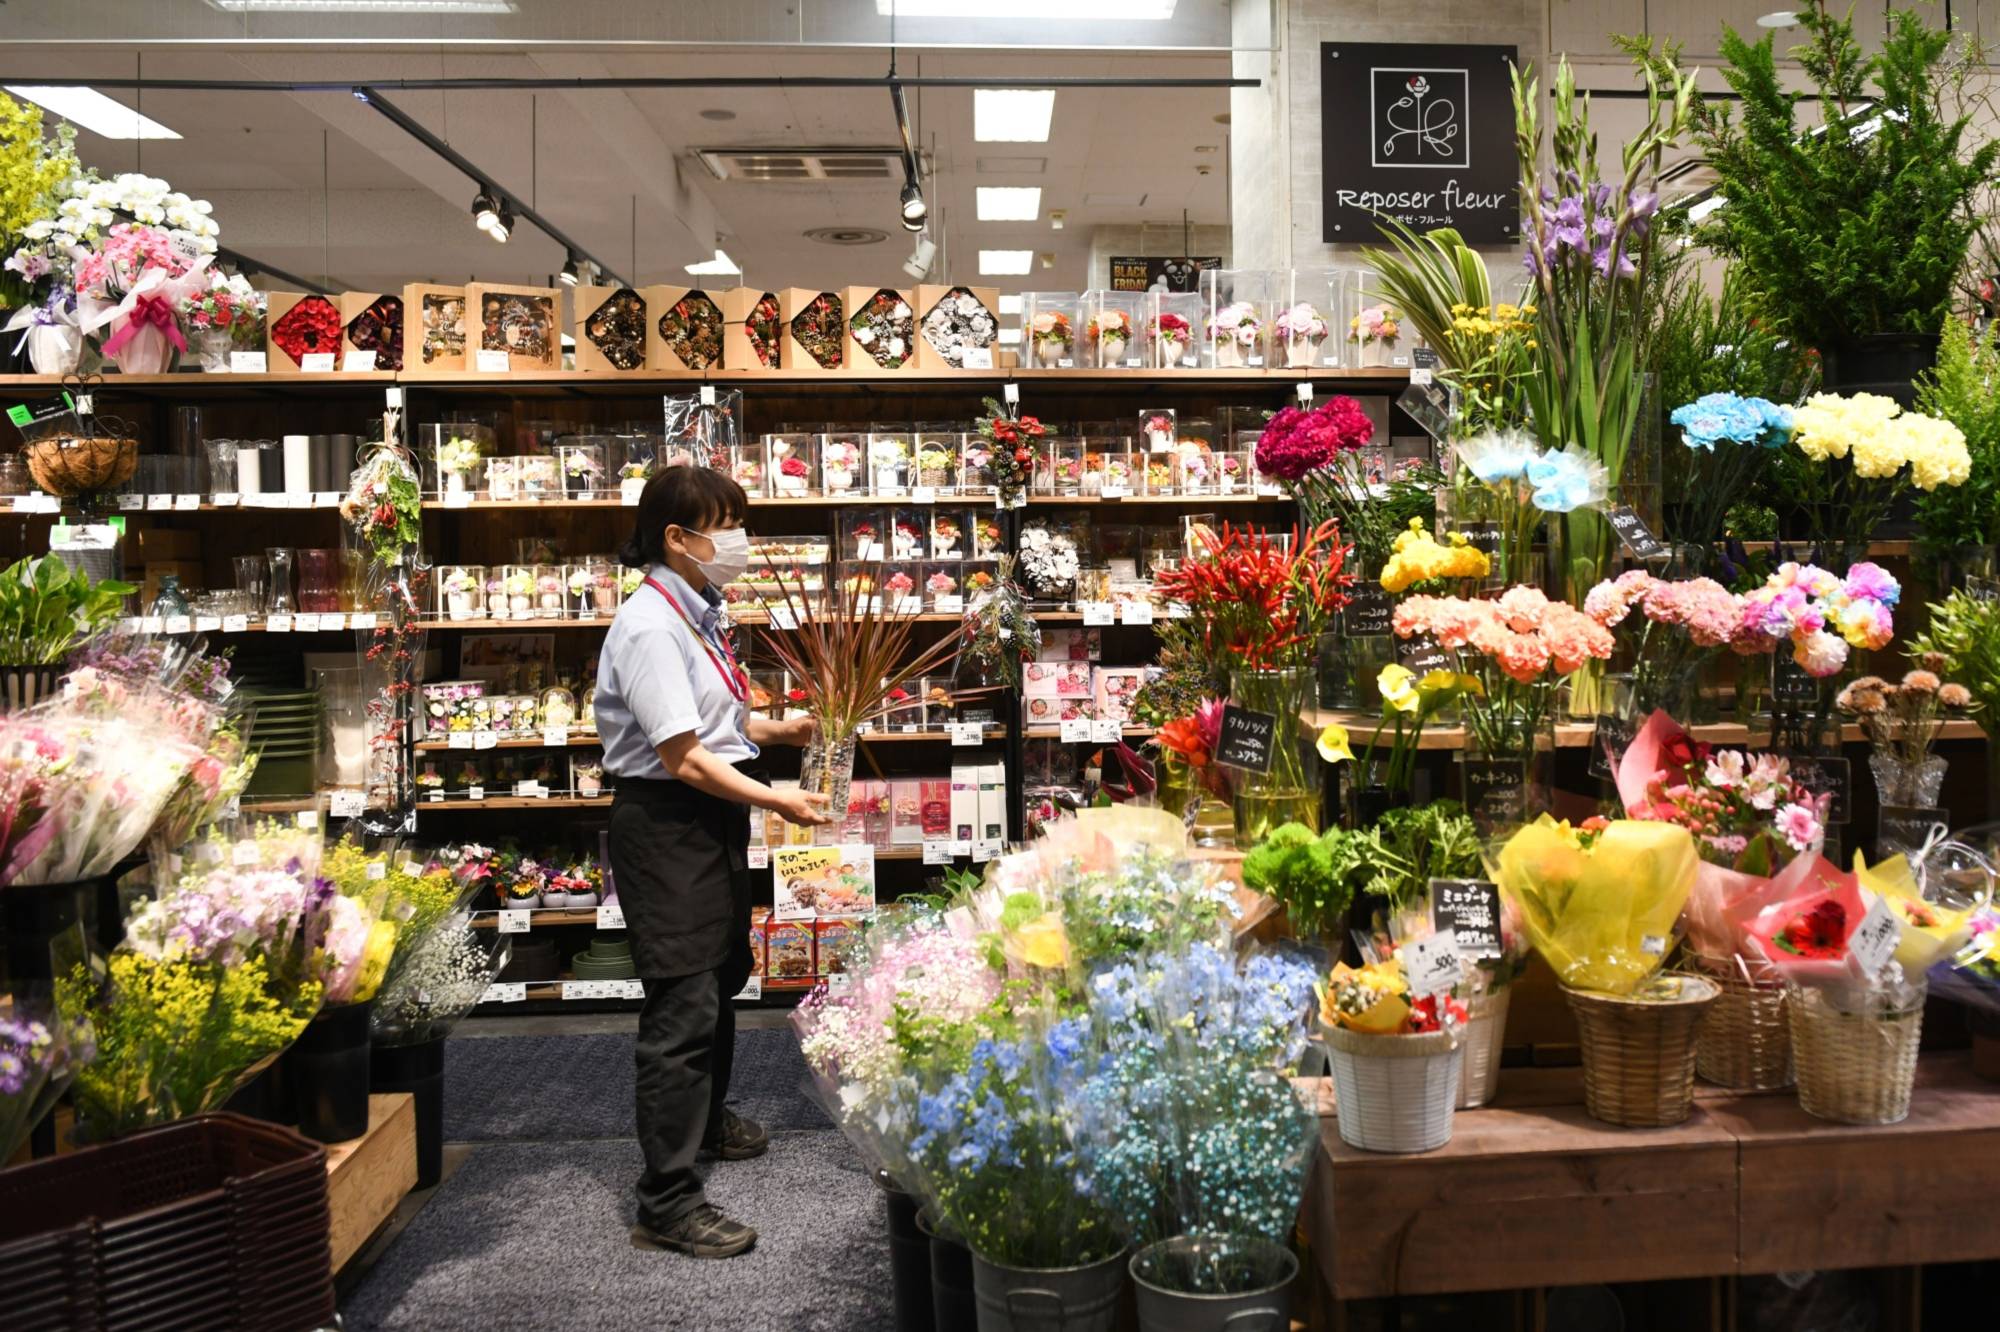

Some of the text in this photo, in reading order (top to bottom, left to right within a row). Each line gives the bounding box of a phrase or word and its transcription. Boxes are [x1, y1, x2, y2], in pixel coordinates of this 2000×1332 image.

[1336, 179, 1506, 217] Reposer fleur
[1114, 265, 1147, 277] BLACK
[1114, 278, 1147, 290] FRIDAY
[779, 851, 809, 866] きのこ
[781, 858, 830, 877] はじめました
[1443, 885, 1491, 904] ミニブーケ
